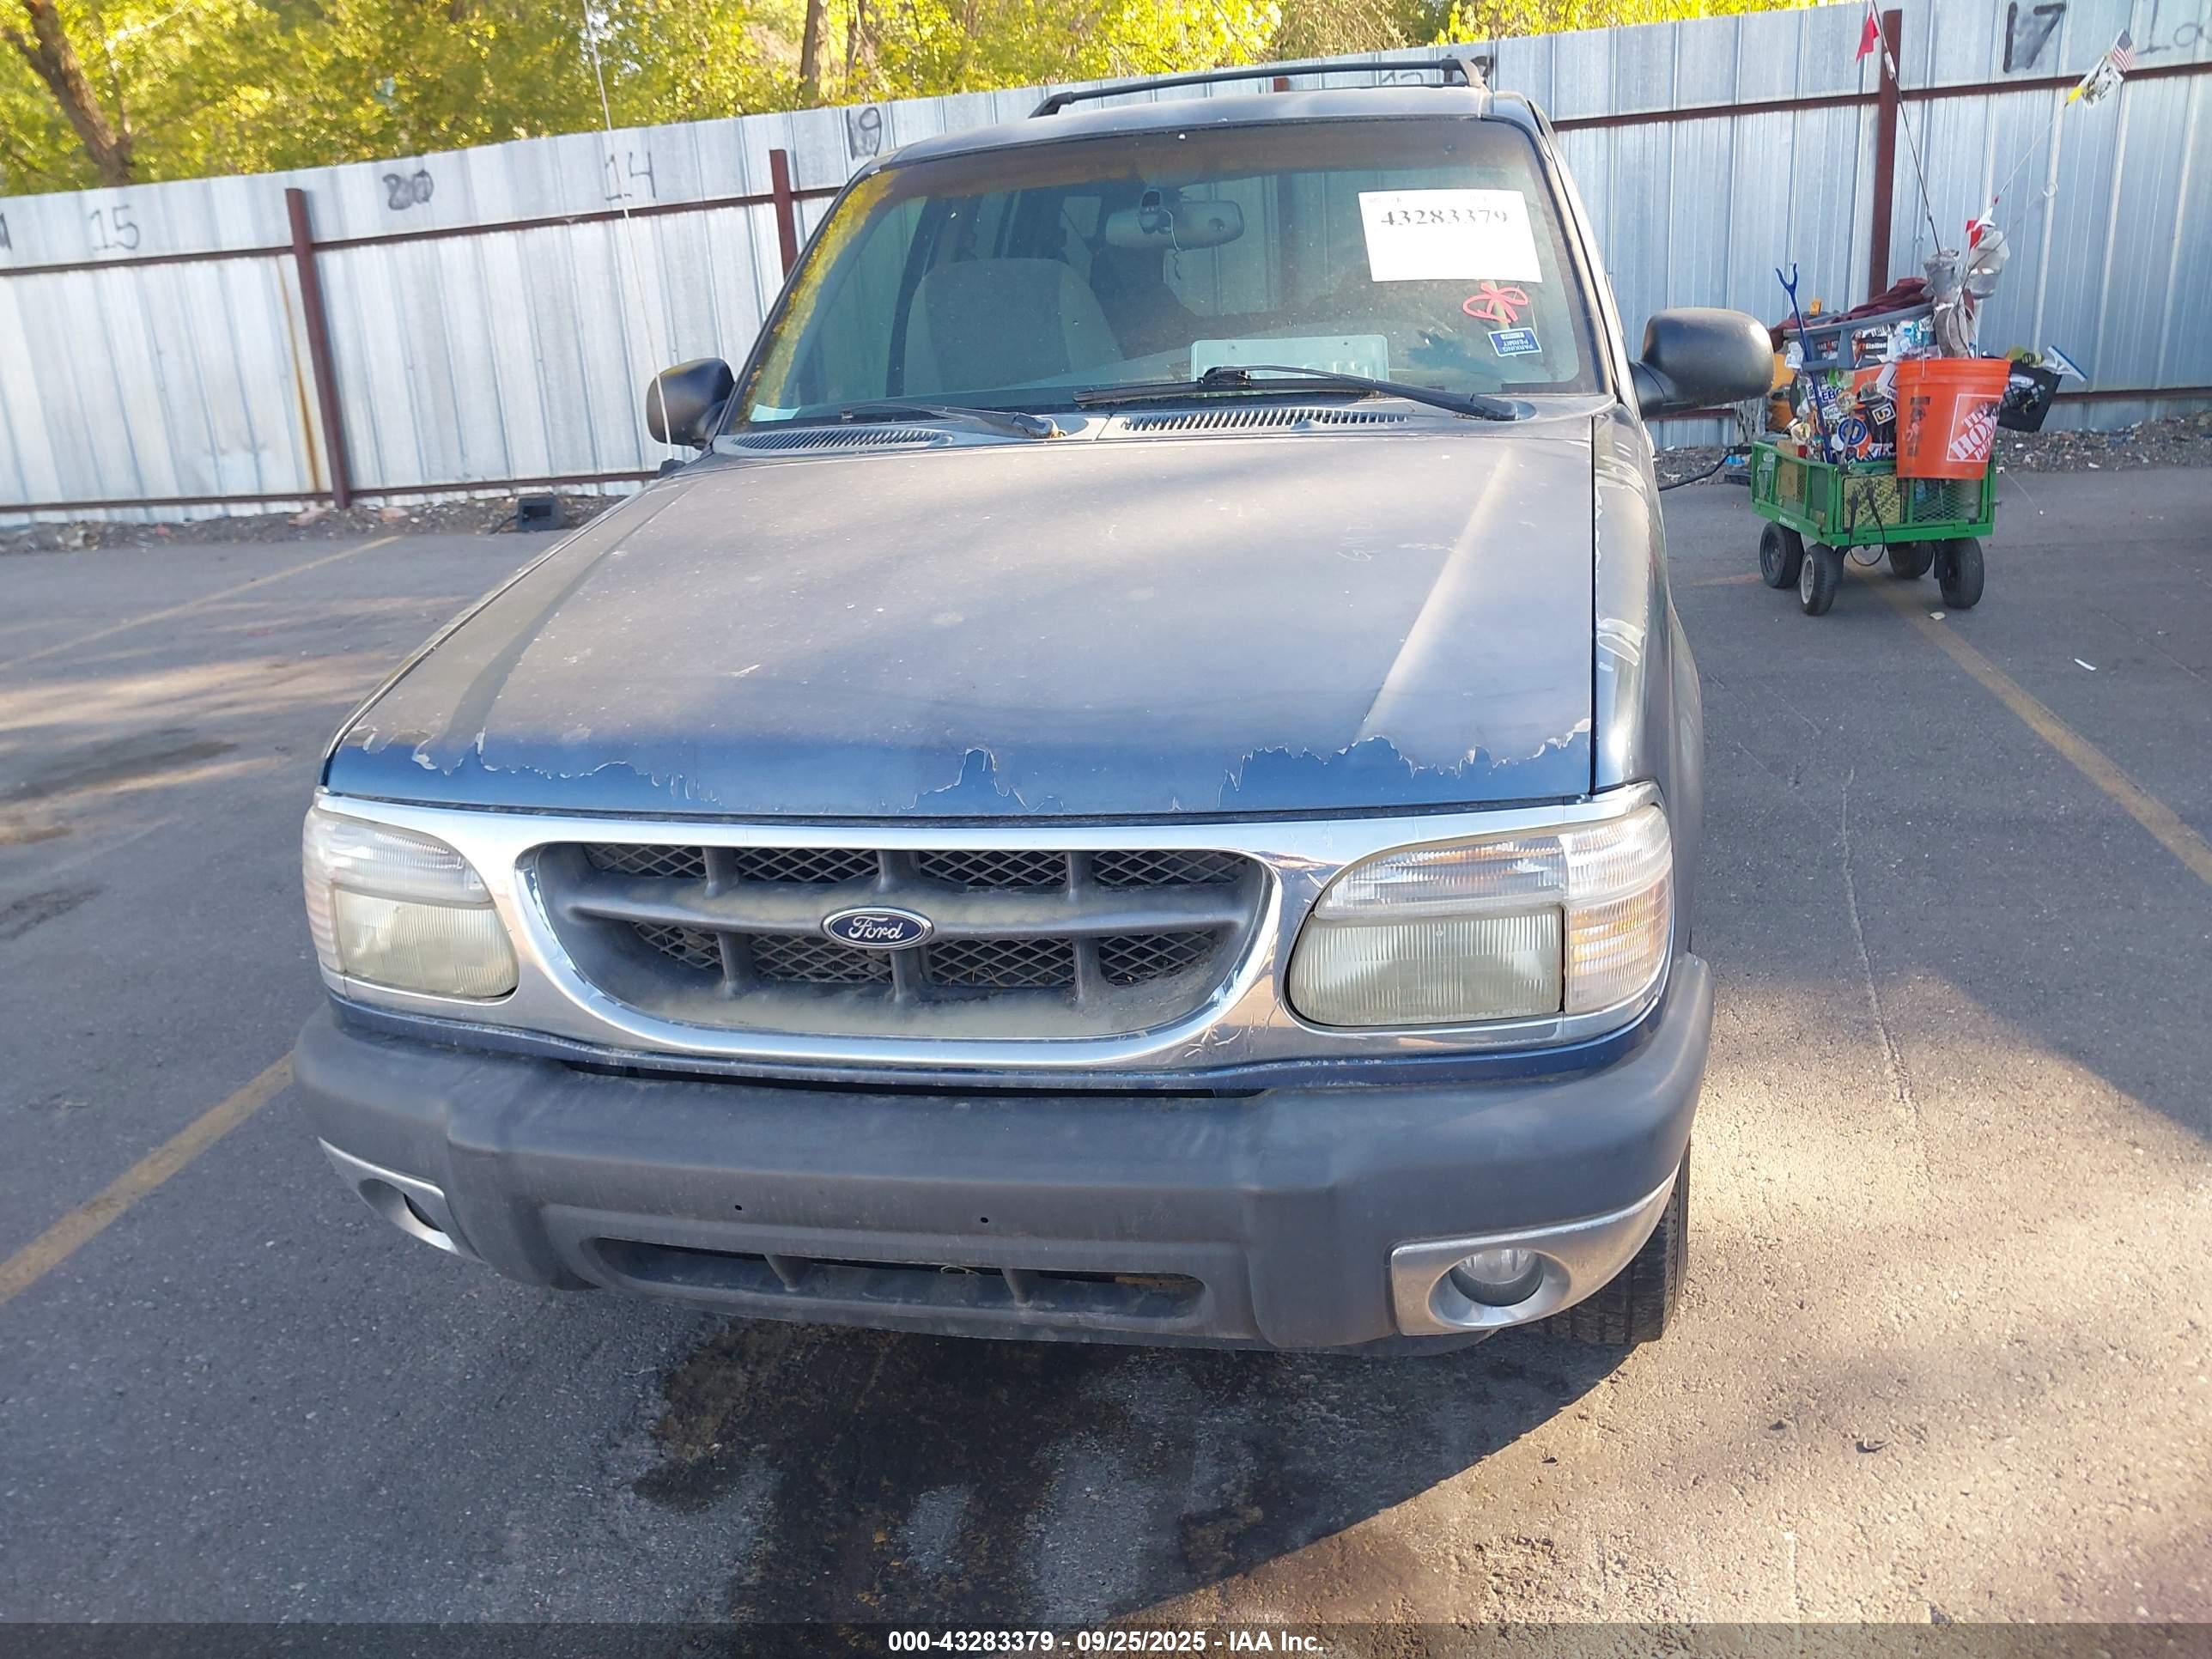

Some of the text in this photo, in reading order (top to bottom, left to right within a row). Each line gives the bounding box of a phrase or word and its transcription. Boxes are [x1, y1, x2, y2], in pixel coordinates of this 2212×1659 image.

[2002, 2, 2067, 72] 17
[605, 150, 657, 200] 14
[88, 204, 141, 251] 15
[1380, 208, 1508, 227] 43283379
[1950, 407, 1999, 460] HOM
[848, 915, 903, 939] Ford
